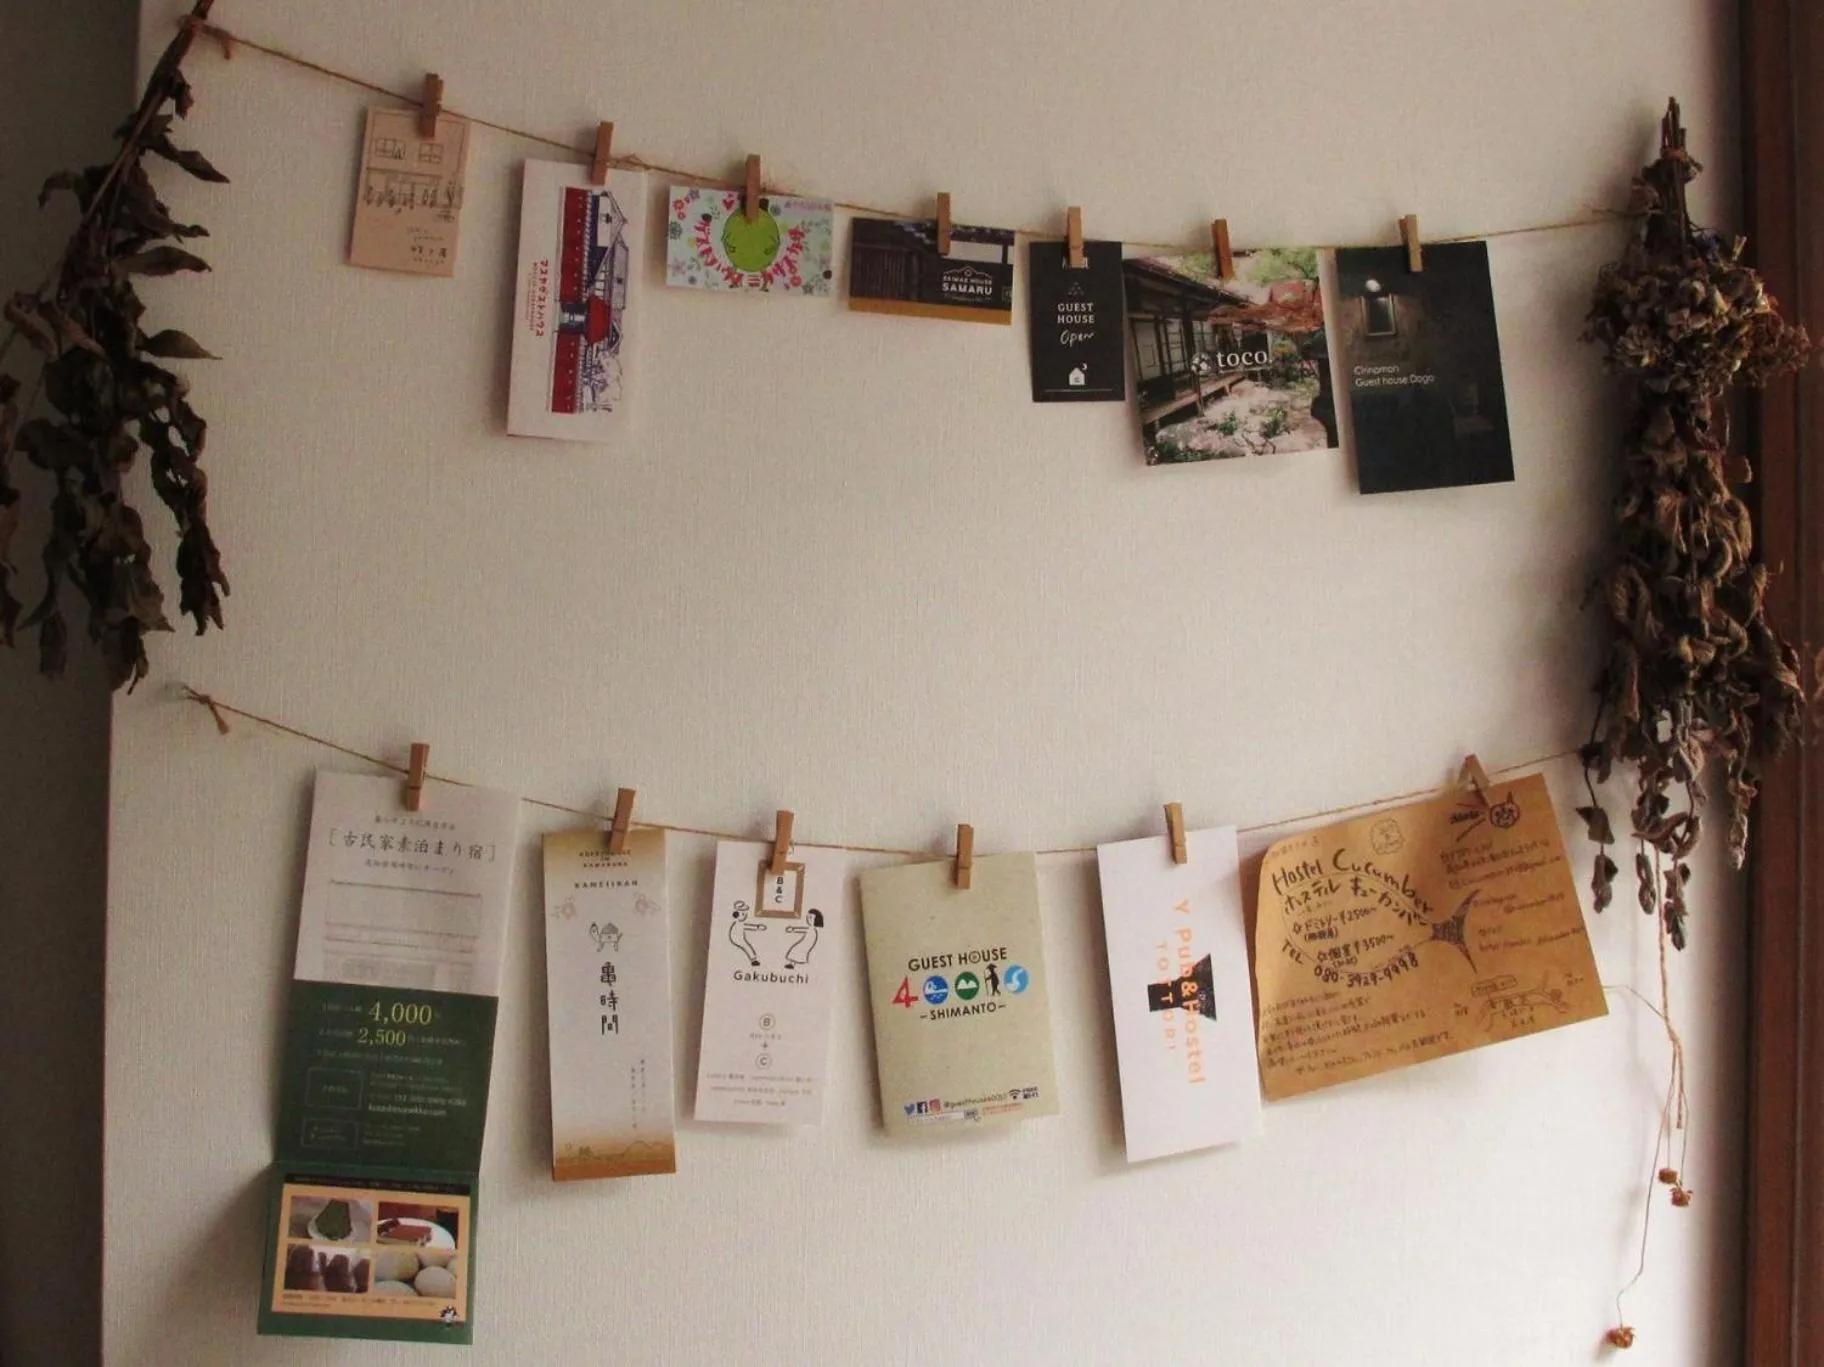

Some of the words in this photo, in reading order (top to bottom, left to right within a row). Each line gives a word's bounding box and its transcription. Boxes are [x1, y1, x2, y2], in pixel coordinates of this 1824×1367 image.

[942, 282, 993, 296] SAMARU
[1057, 302, 1094, 313] GUEST
[1057, 314, 1096, 325] HOUSE
[1060, 328, 1097, 348] Open
[1354, 376, 1380, 387] Guest
[1382, 376, 1408, 386] house
[1271, 858, 1324, 896] Hostel
[1172, 898, 1191, 915] Y
[907, 954, 954, 972] GUEST
[958, 946, 1008, 966] HOUSE
[733, 969, 810, 985] Gakubuchi
[599, 961, 620, 1037] 亀時間
[368, 1000, 433, 1026] 4,000
[356, 1026, 406, 1047] 2,500
